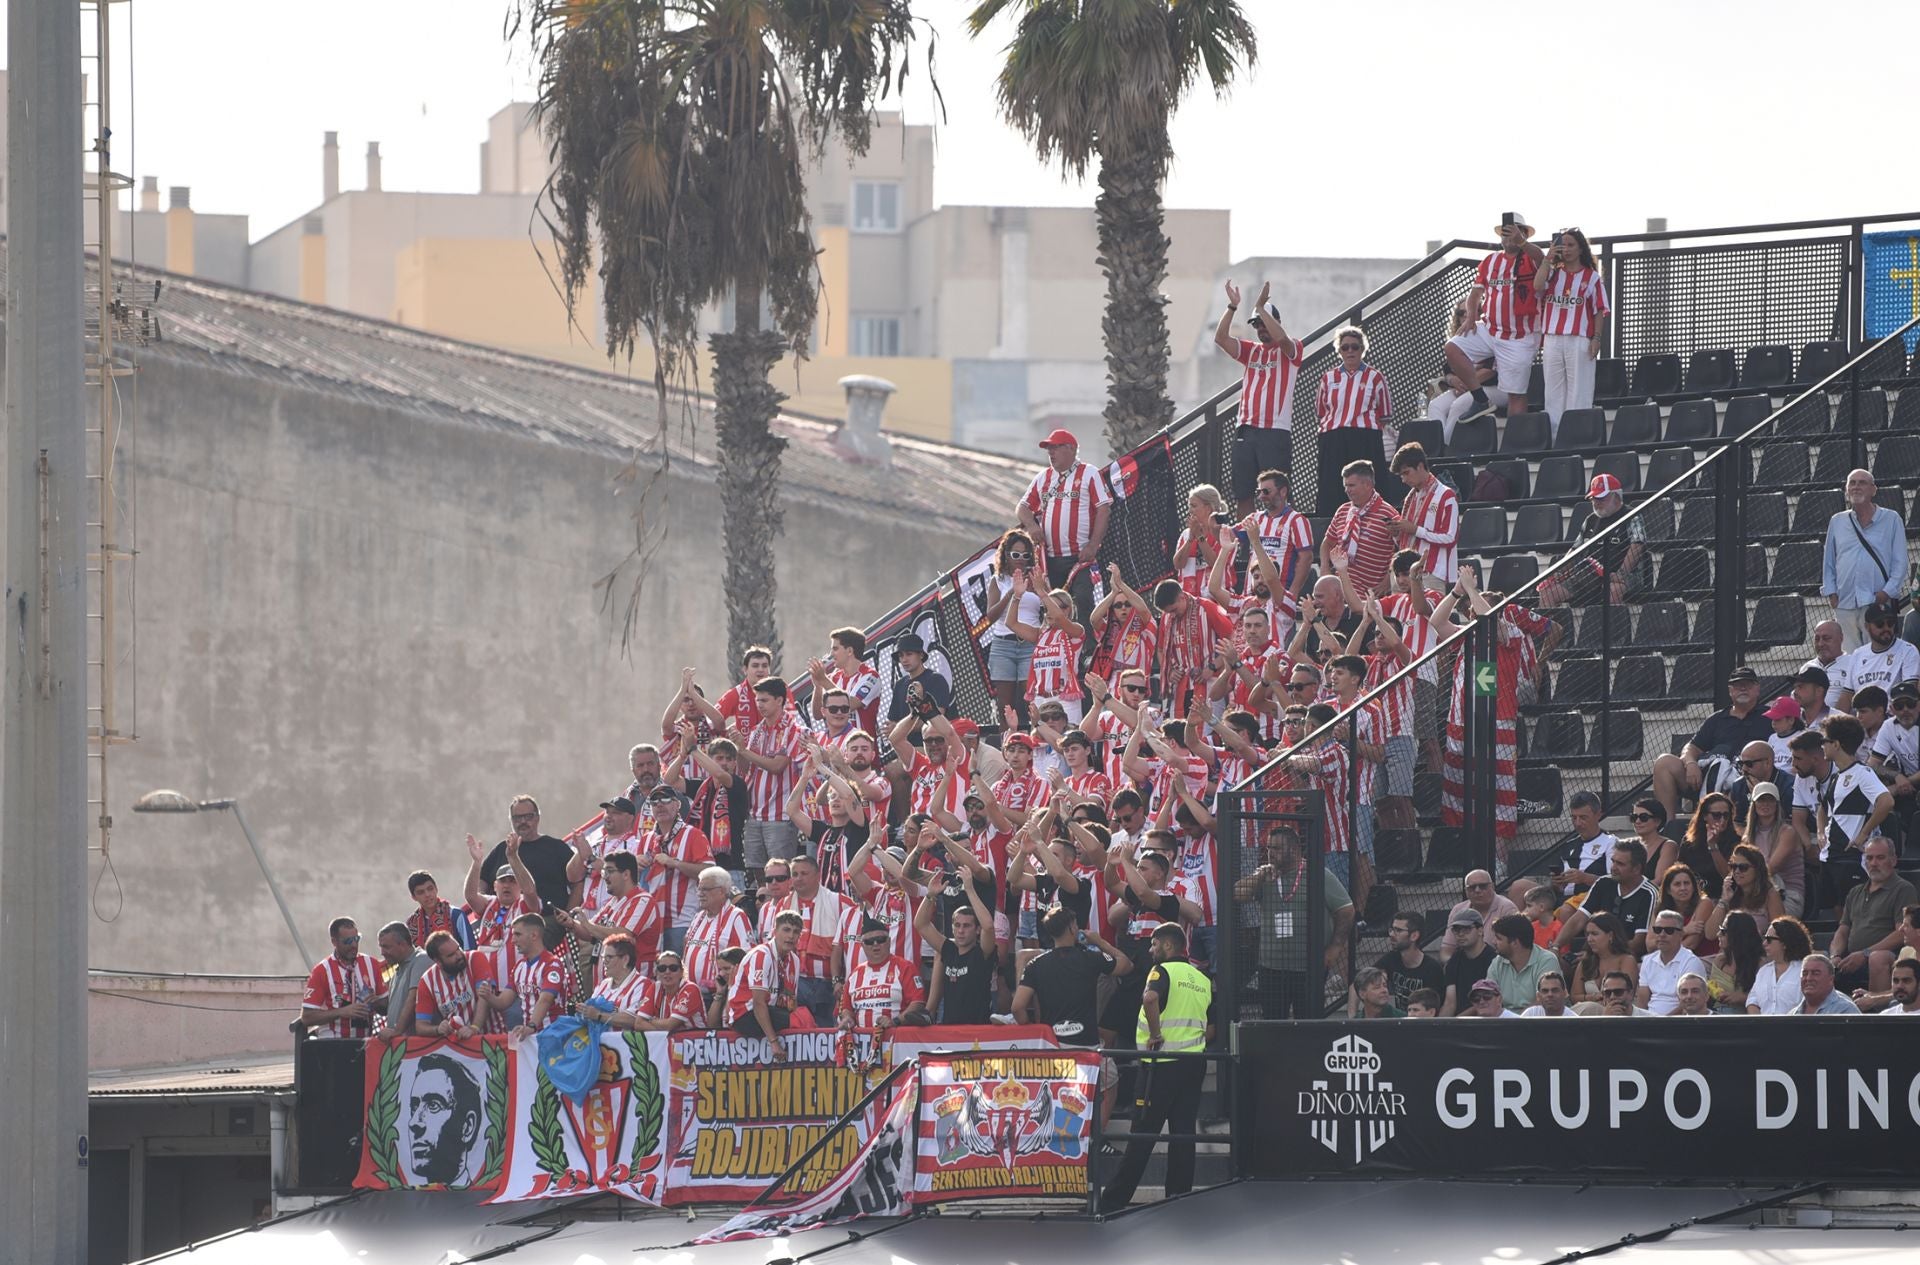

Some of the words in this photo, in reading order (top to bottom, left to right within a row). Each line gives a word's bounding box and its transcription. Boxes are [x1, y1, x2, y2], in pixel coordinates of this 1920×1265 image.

[1858, 671, 1892, 686] CEUTA
[682, 1031, 735, 1066] PEÑA
[983, 1058, 1078, 1080] SPORTINGUISTA
[1326, 1054, 1379, 1070] GRUPO
[696, 1068, 865, 1122] SENTIMIENTO
[1297, 1091, 1407, 1115] DINOMAR
[1436, 1067, 1712, 1130] GRUPO
[1755, 1068, 1920, 1130] DIN
[931, 1166, 1012, 1191] SENTIMIENTO
